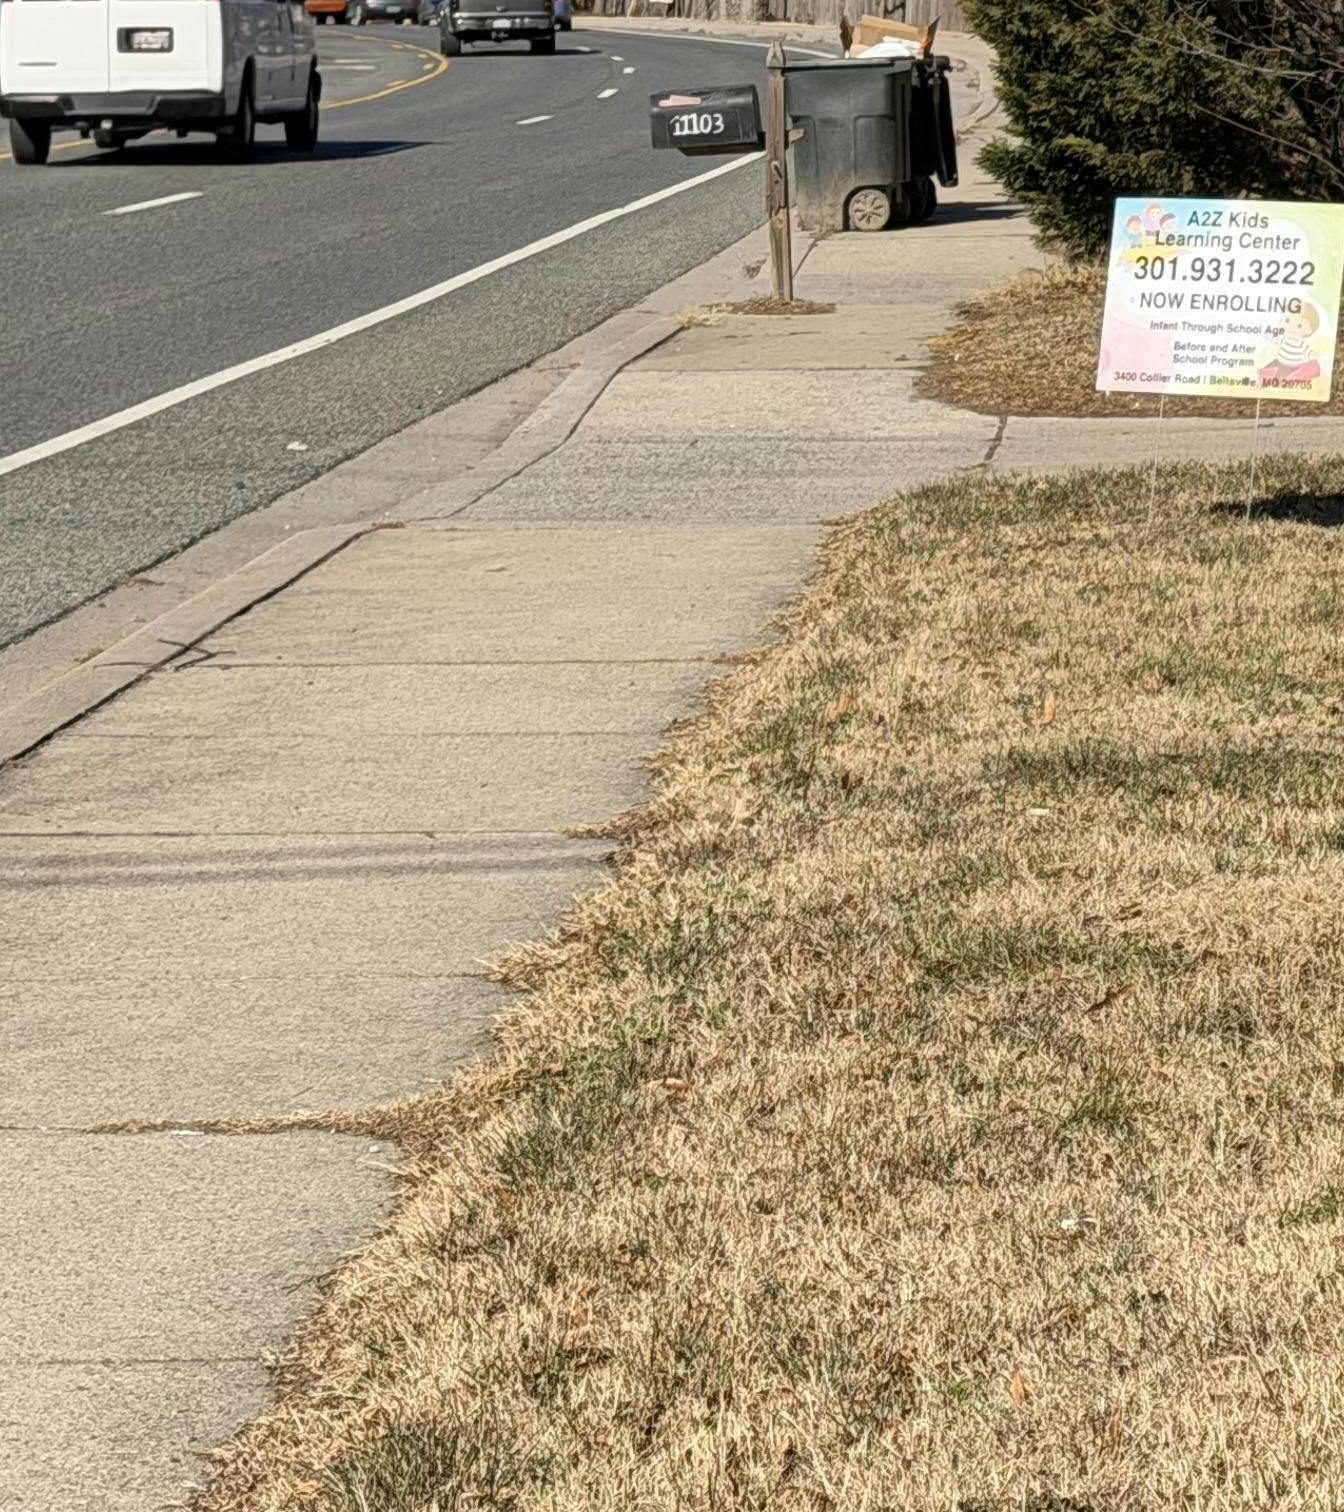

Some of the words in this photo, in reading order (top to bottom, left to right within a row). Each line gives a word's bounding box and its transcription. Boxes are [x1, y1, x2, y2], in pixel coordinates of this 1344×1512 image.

[1187, 210, 1223, 227] A2Z
[1228, 212, 1269, 229] Kids
[1155, 230, 1233, 252] Learning
[1239, 232, 1301, 250] Center
[1134, 255, 1316, 286] 301.931.3222
[1140, 292, 1185, 309] NOW
[1190, 293, 1302, 314] ENROLLING
[1150, 320, 1178, 331] Infant
[1182, 321, 1224, 334] Through
[1226, 323, 1262, 335] School
[1265, 325, 1286, 337] Age
[1174, 341, 1206, 352] Before
[1209, 342, 1229, 353] and
[1231, 342, 1256, 354] After
[1172, 353, 1207, 365] School
[1210, 355, 1255, 368] Program
[1174, 373, 1201, 385] Road
